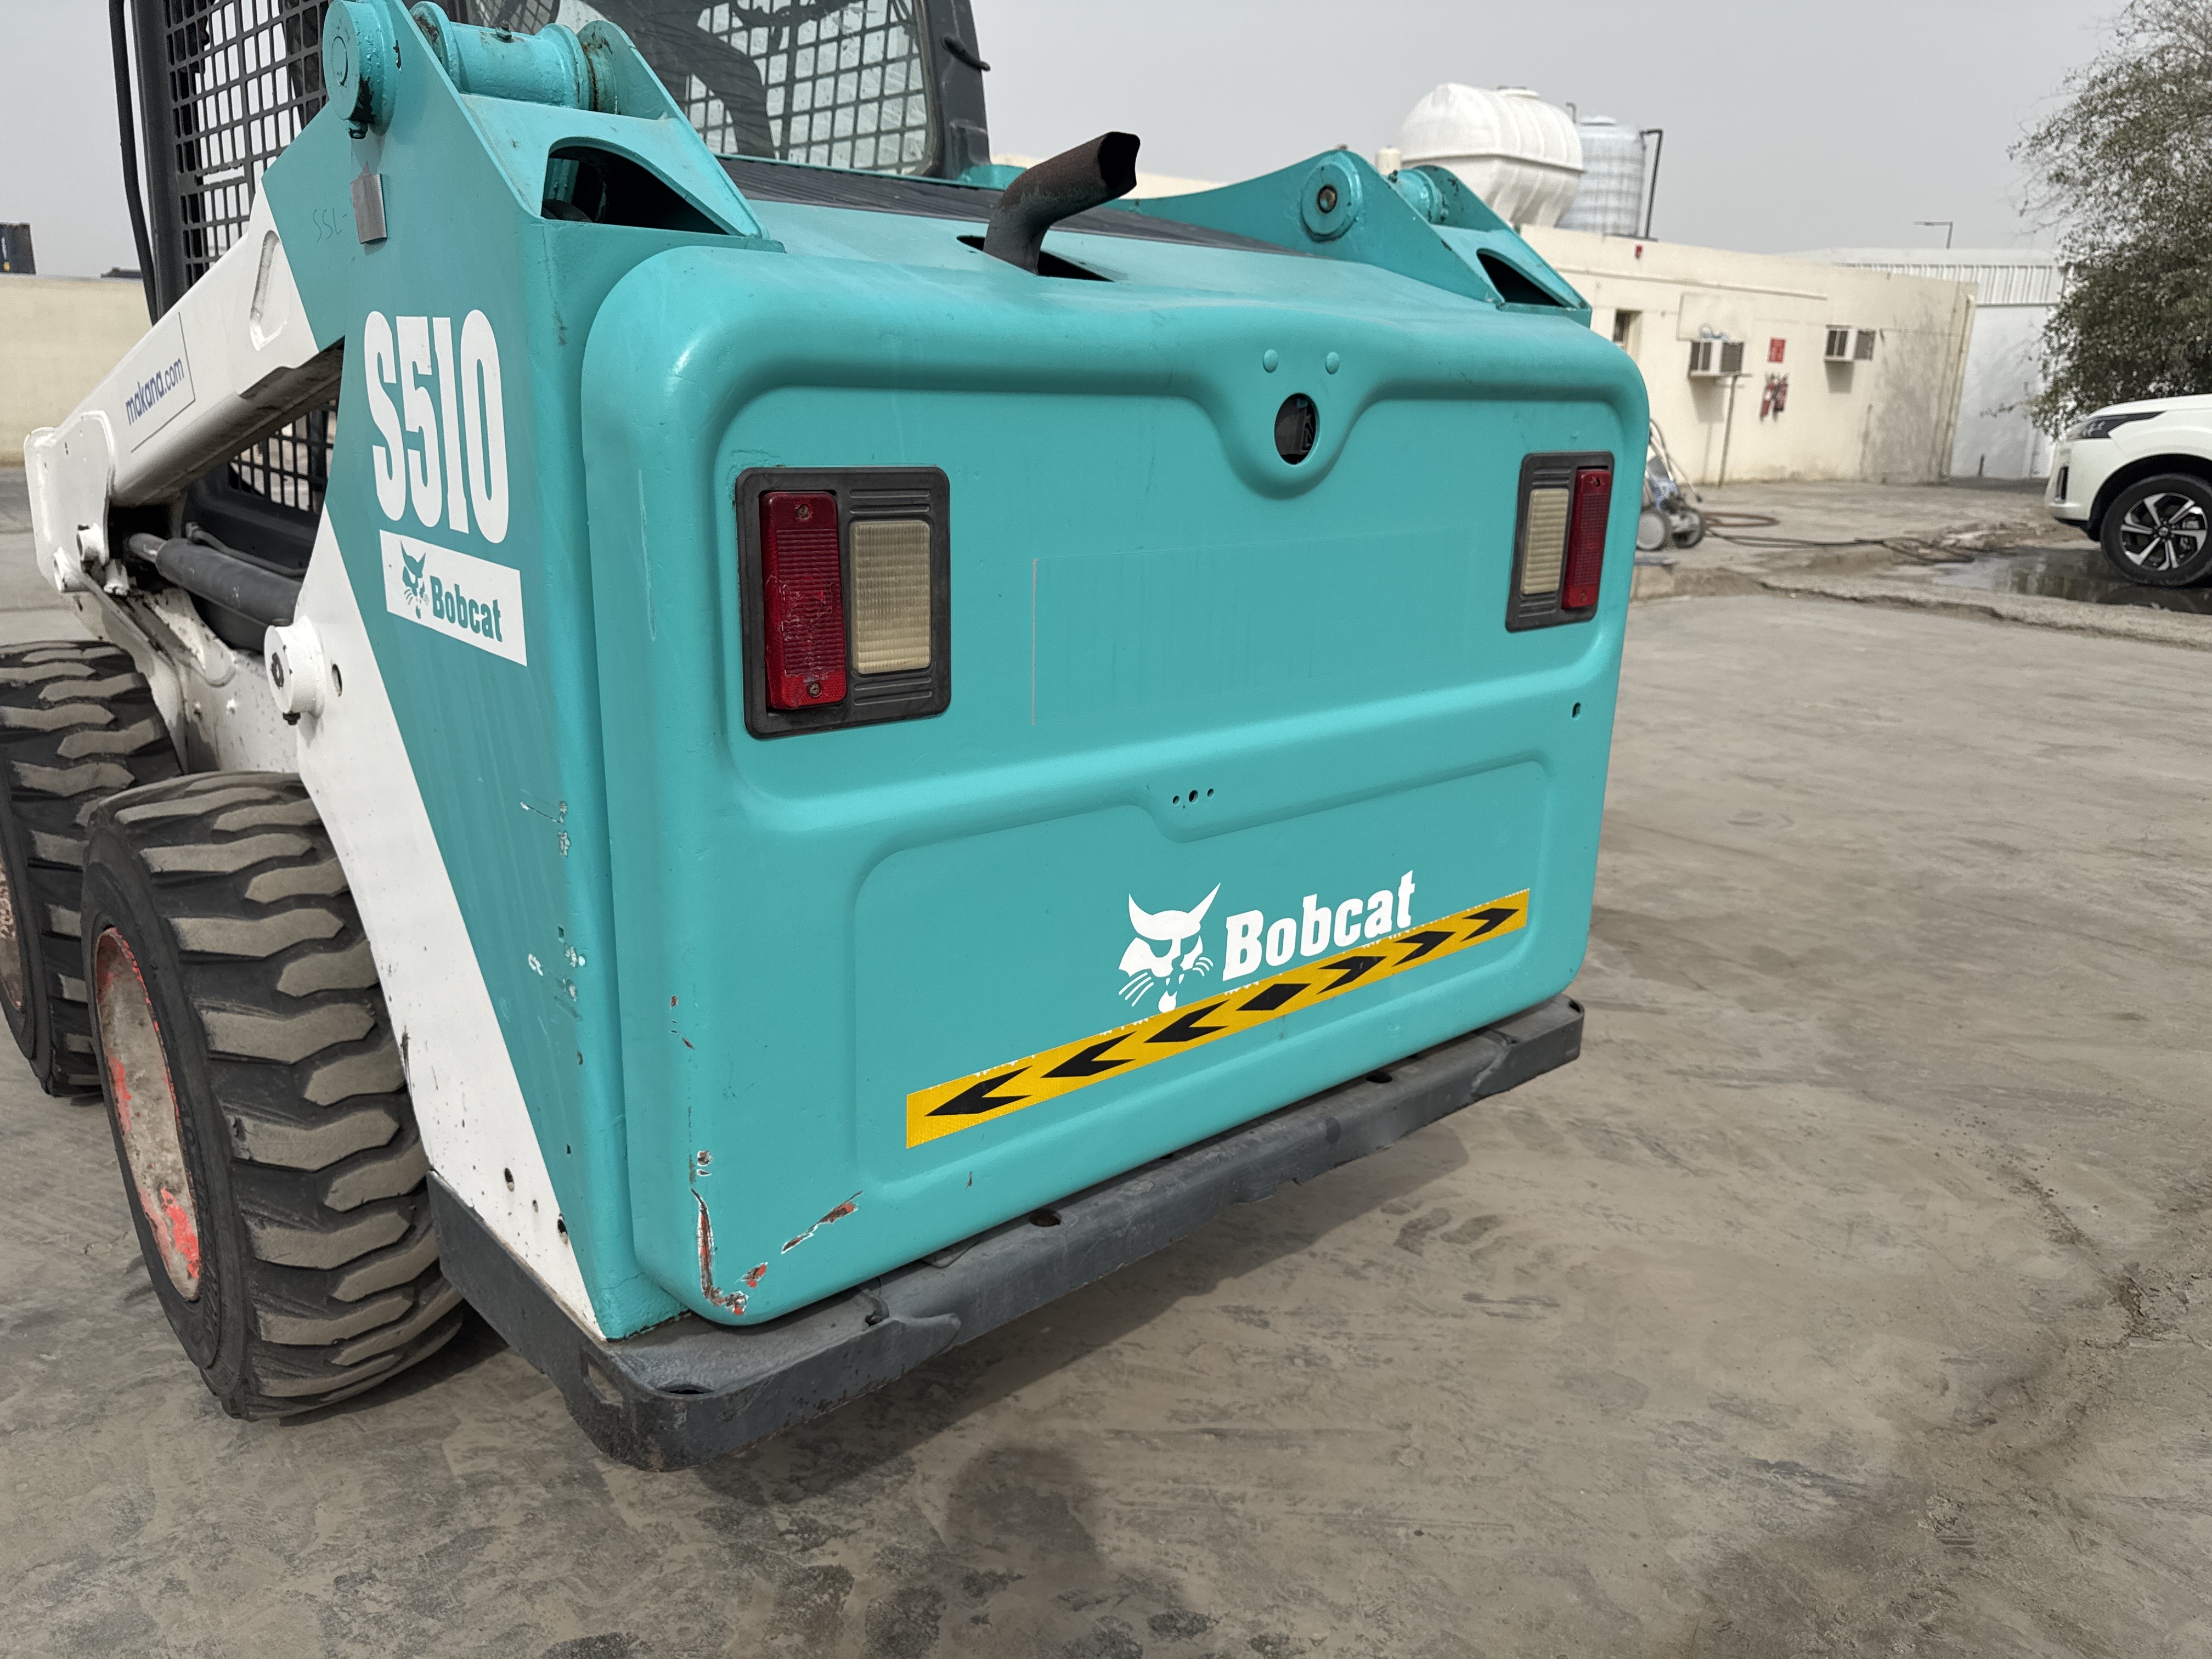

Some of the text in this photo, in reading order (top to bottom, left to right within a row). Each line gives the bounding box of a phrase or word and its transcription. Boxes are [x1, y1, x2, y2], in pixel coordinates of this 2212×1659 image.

[126, 358, 185, 425] makana.com
[364, 309, 509, 544] S510
[430, 575, 503, 642] Bobcat
[1222, 870, 1415, 981] Bobcat
